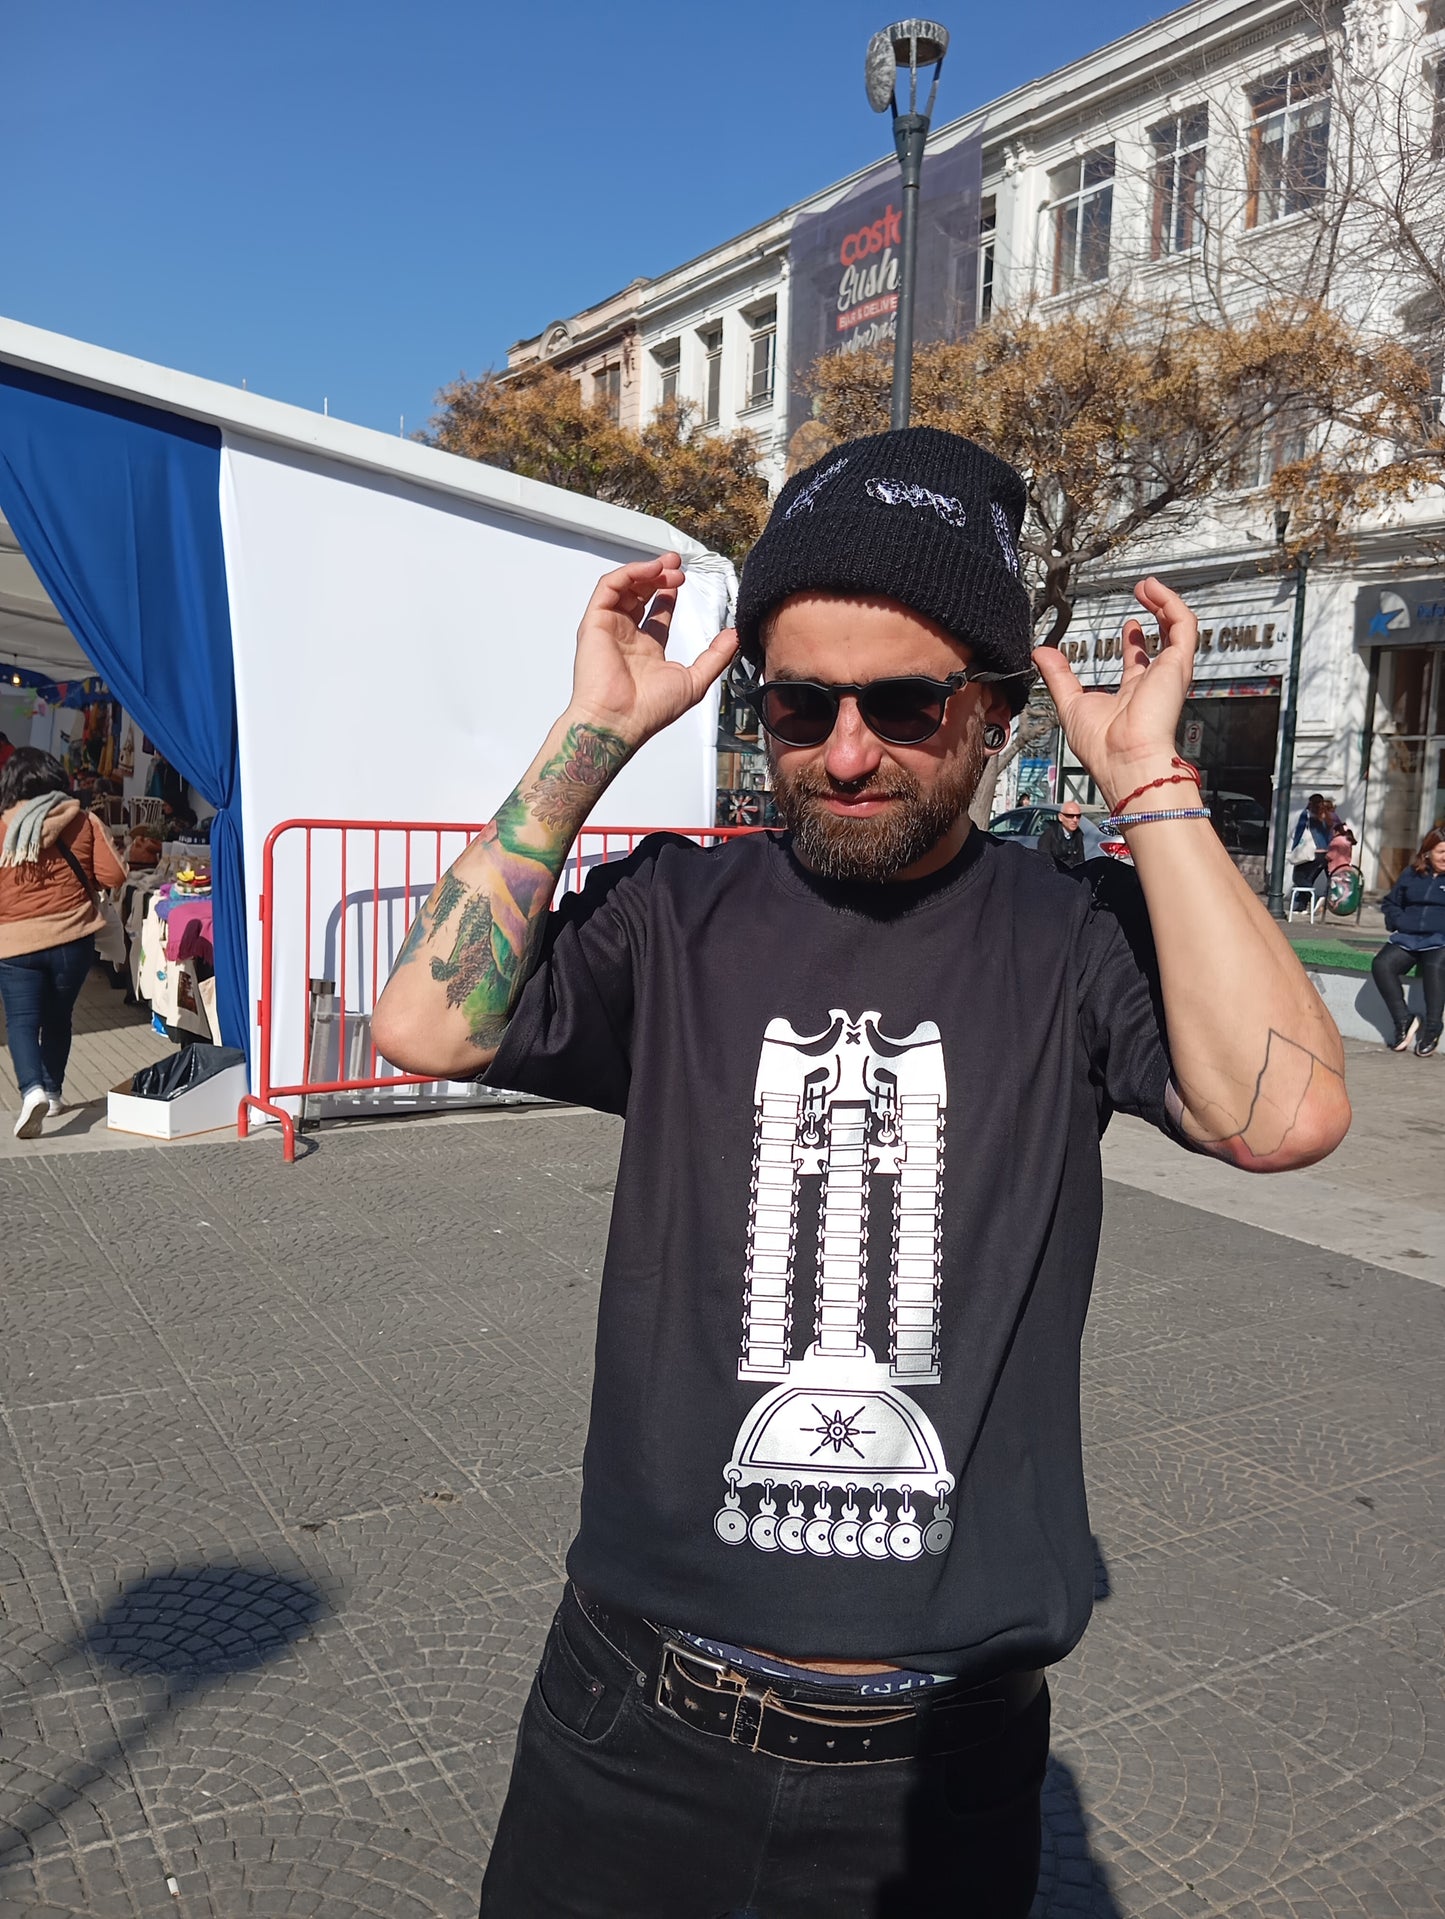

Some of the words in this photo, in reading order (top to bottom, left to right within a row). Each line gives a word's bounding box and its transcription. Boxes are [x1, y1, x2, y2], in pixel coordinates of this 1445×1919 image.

[837, 247, 901, 312] Sush
[863, 295, 898, 317] DELIVE
[1217, 623, 1275, 653] CHILE
